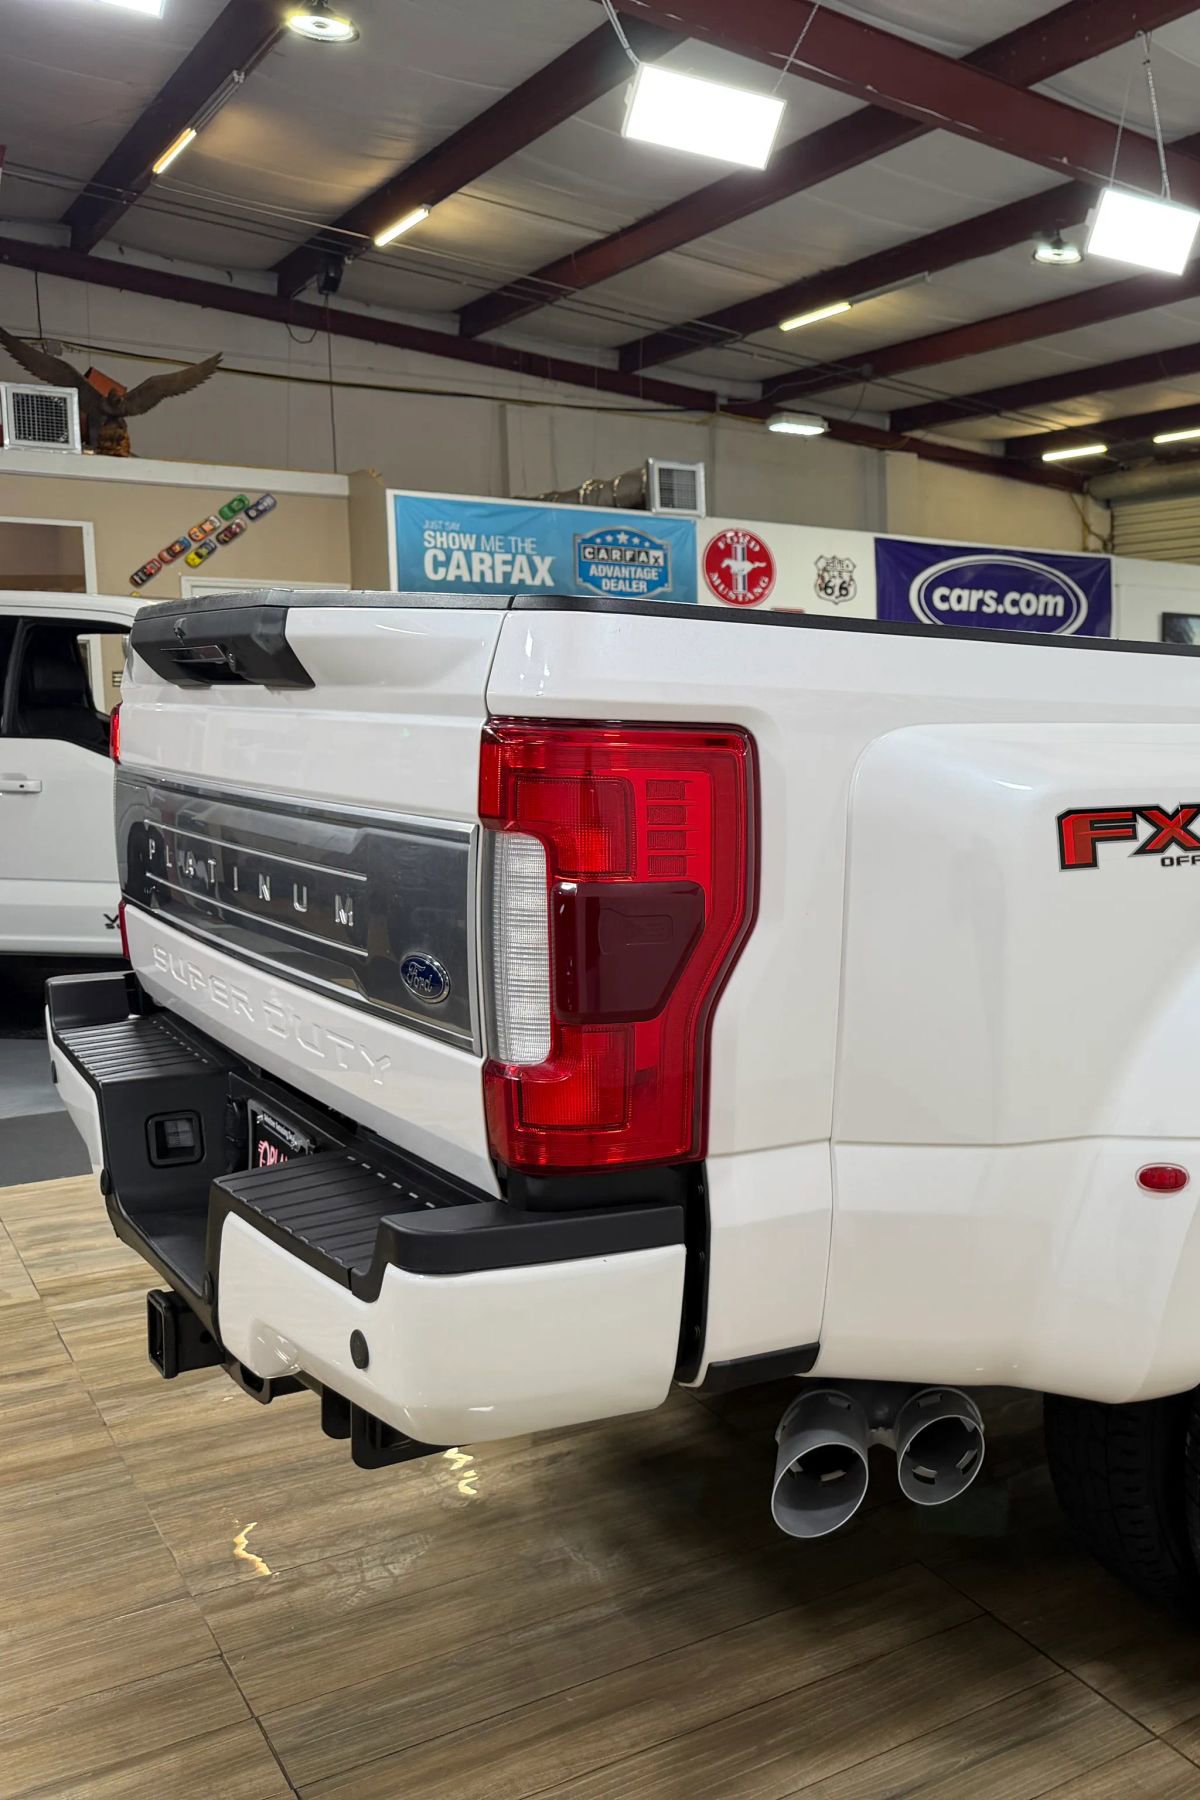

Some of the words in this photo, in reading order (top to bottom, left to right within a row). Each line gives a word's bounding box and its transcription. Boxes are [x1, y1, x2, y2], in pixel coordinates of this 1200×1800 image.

[423, 530, 477, 550] SHOW
[481, 534, 505, 552] ME
[508, 536, 538, 555] THE
[717, 531, 761, 552] FORD
[423, 547, 556, 587] CARFAX
[583, 546, 663, 566] CARFAX
[589, 564, 659, 581] ADVANTAGE
[601, 578, 648, 593] DEALER
[709, 571, 770, 602] MUSTANG
[824, 579, 849, 598] 66
[932, 586, 1065, 617] cars.com
[148, 838, 355, 927] PLATINUM
[405, 961, 434, 994] Ford
[152, 943, 255, 1022] SUPER
[263, 1000, 392, 1086] DUTY
